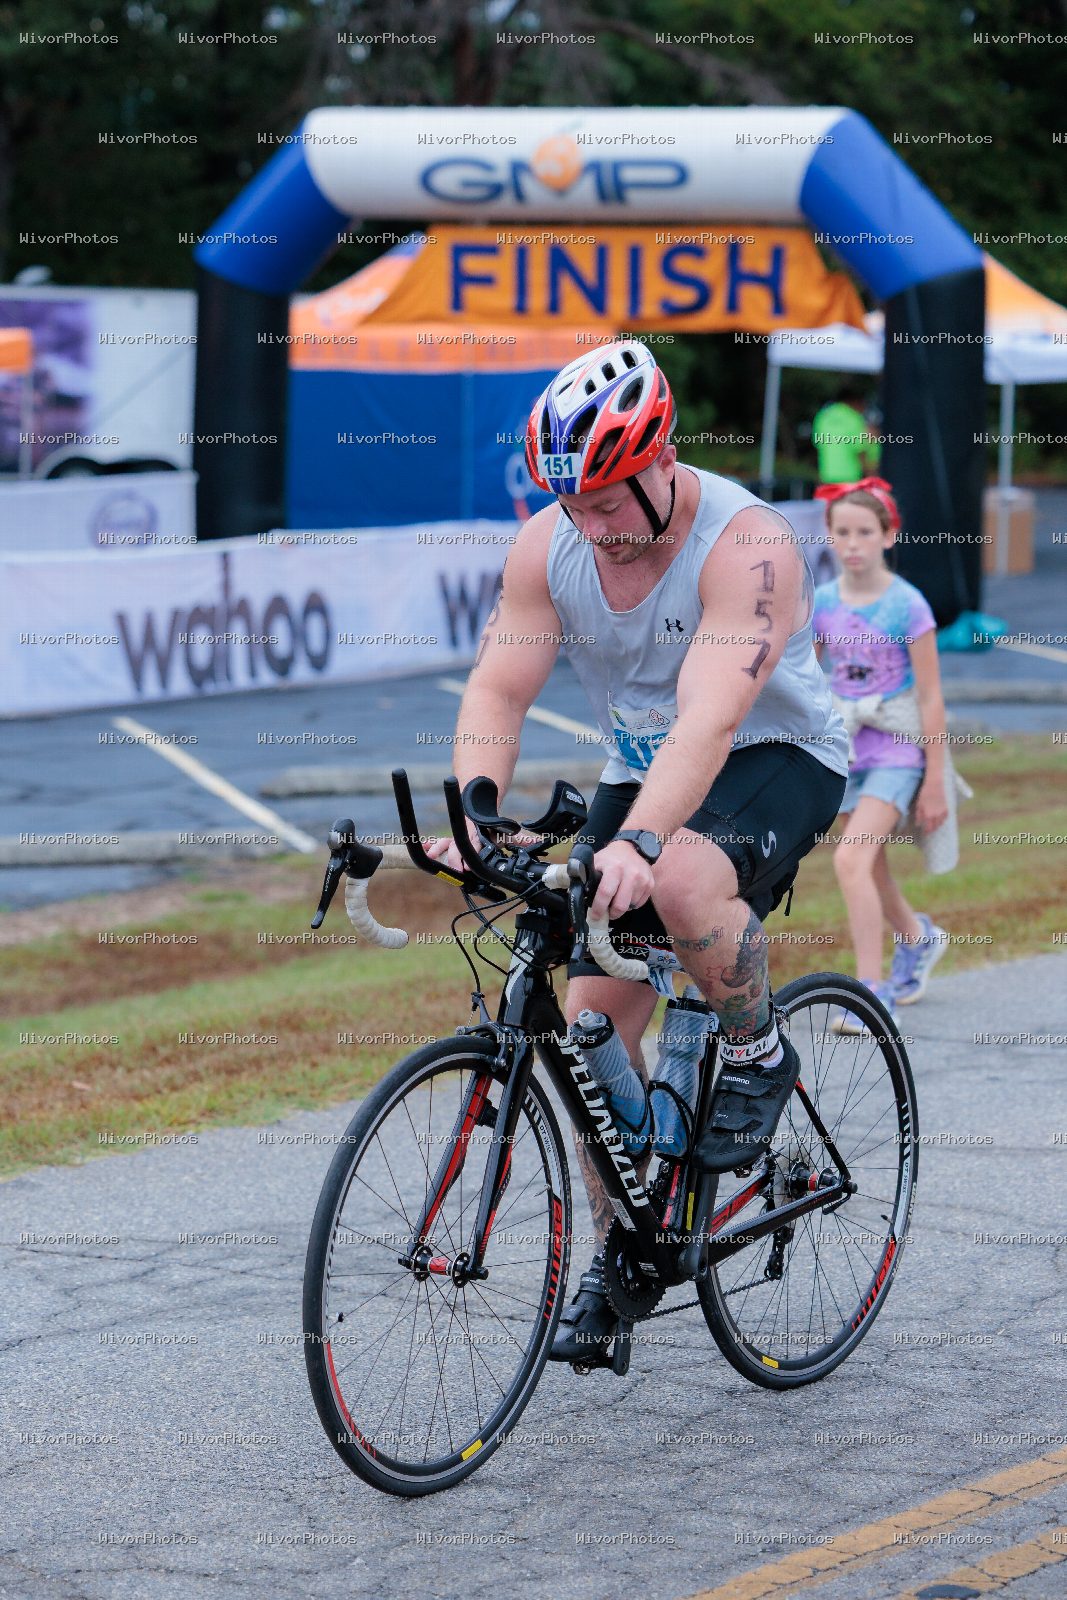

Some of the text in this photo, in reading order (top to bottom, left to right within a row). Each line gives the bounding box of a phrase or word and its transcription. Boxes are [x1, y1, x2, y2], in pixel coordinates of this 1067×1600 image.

[418, 156, 689, 204] GMP
[449, 243, 787, 318] FINISH
[544, 456, 573, 477] 151
[116, 552, 330, 692] wahoo
[722, 1038, 769, 1059] MYLA
[551, 1027, 650, 1208] SPECIALIZED
